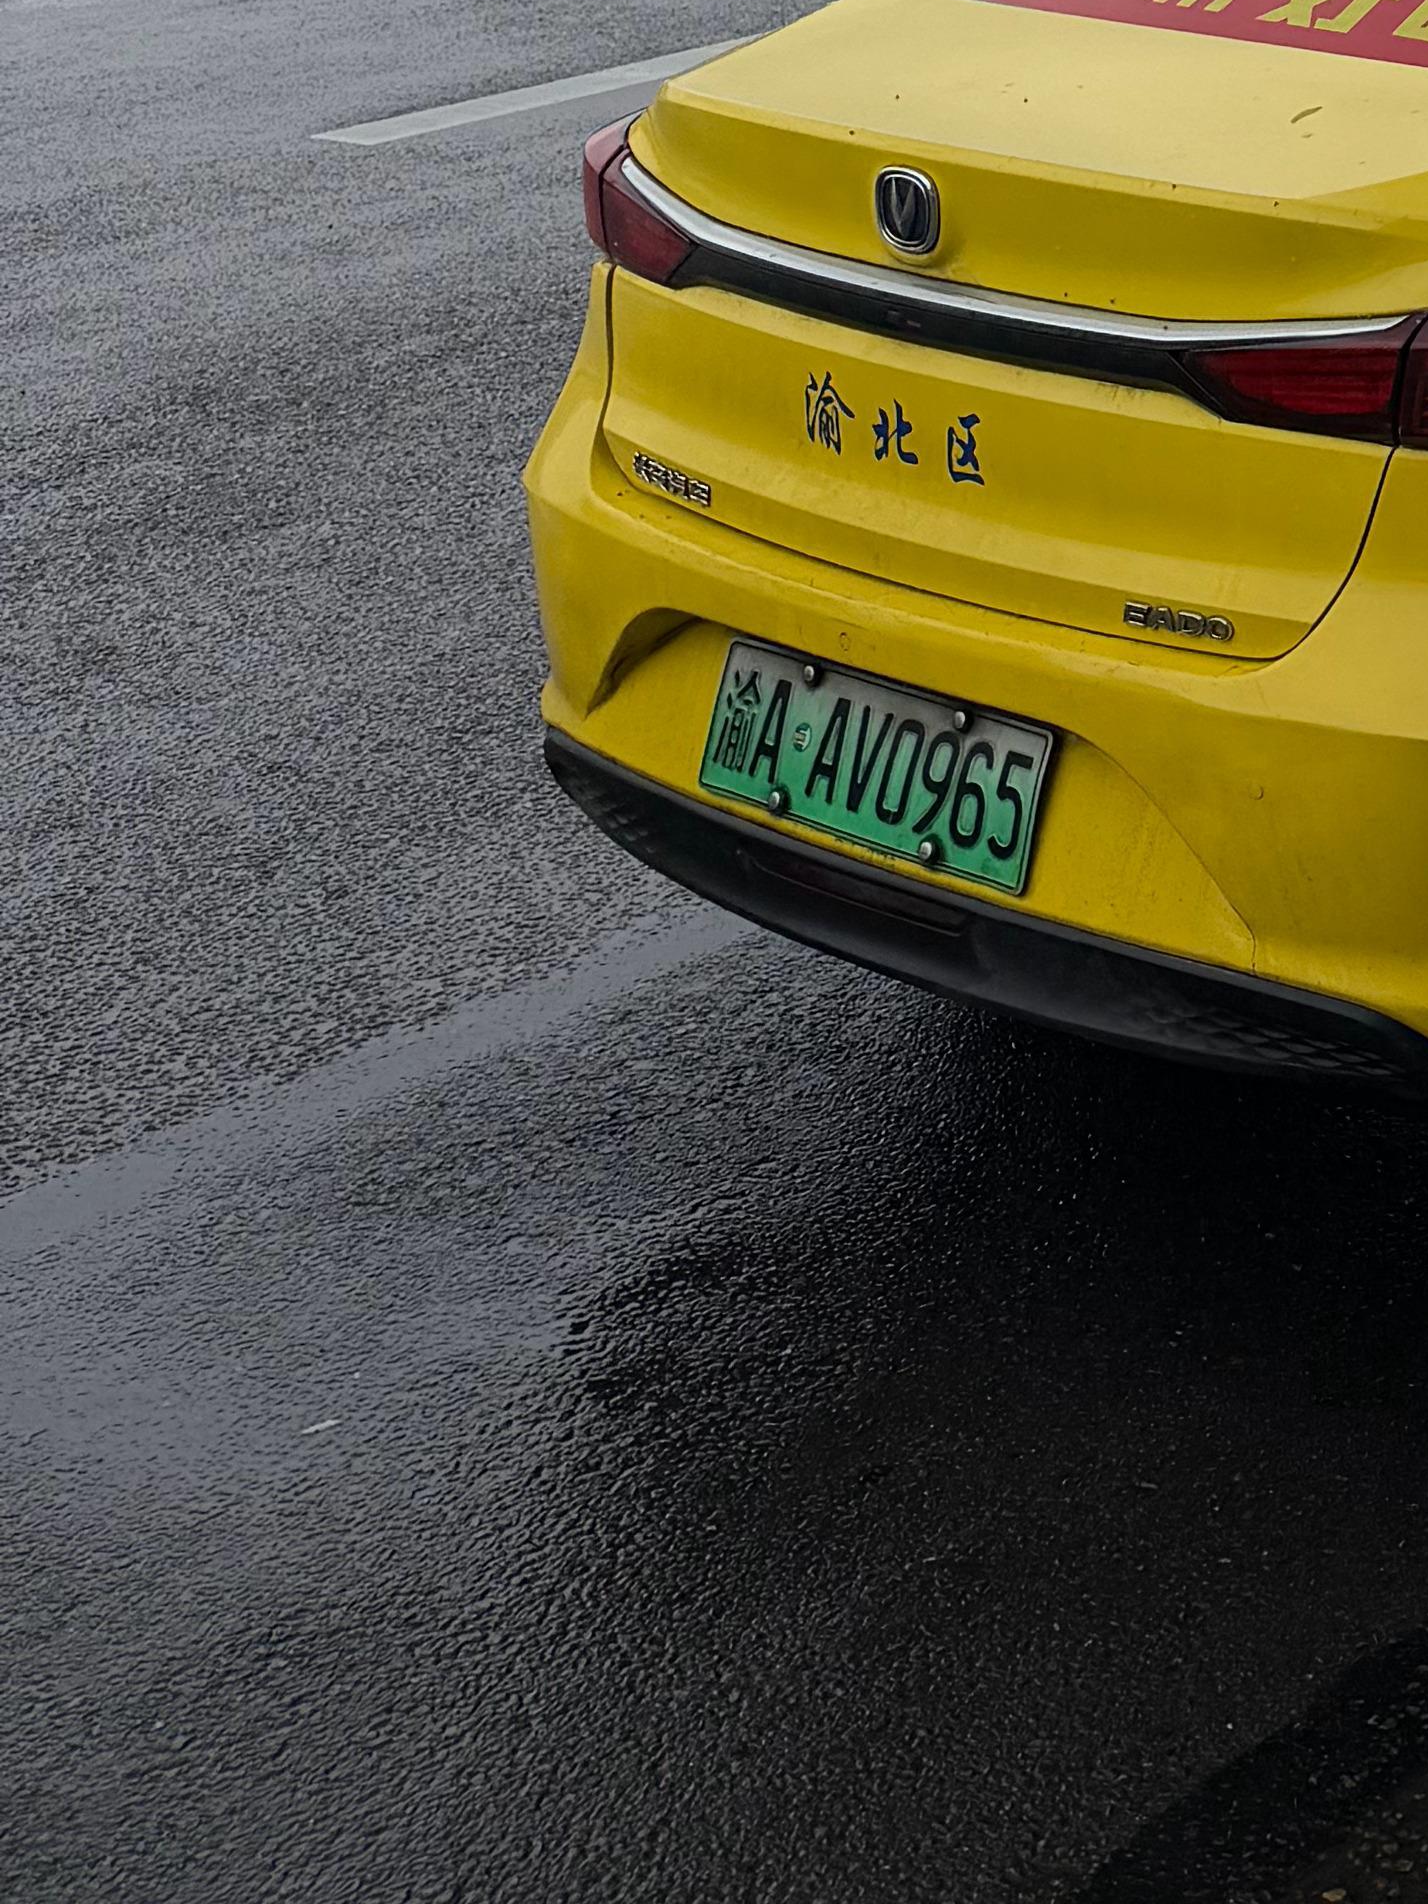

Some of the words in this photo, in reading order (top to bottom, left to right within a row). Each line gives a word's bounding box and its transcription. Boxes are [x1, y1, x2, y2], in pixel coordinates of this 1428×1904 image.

[804, 370, 985, 486] 渝北区
[1123, 600, 1235, 641] EADO
